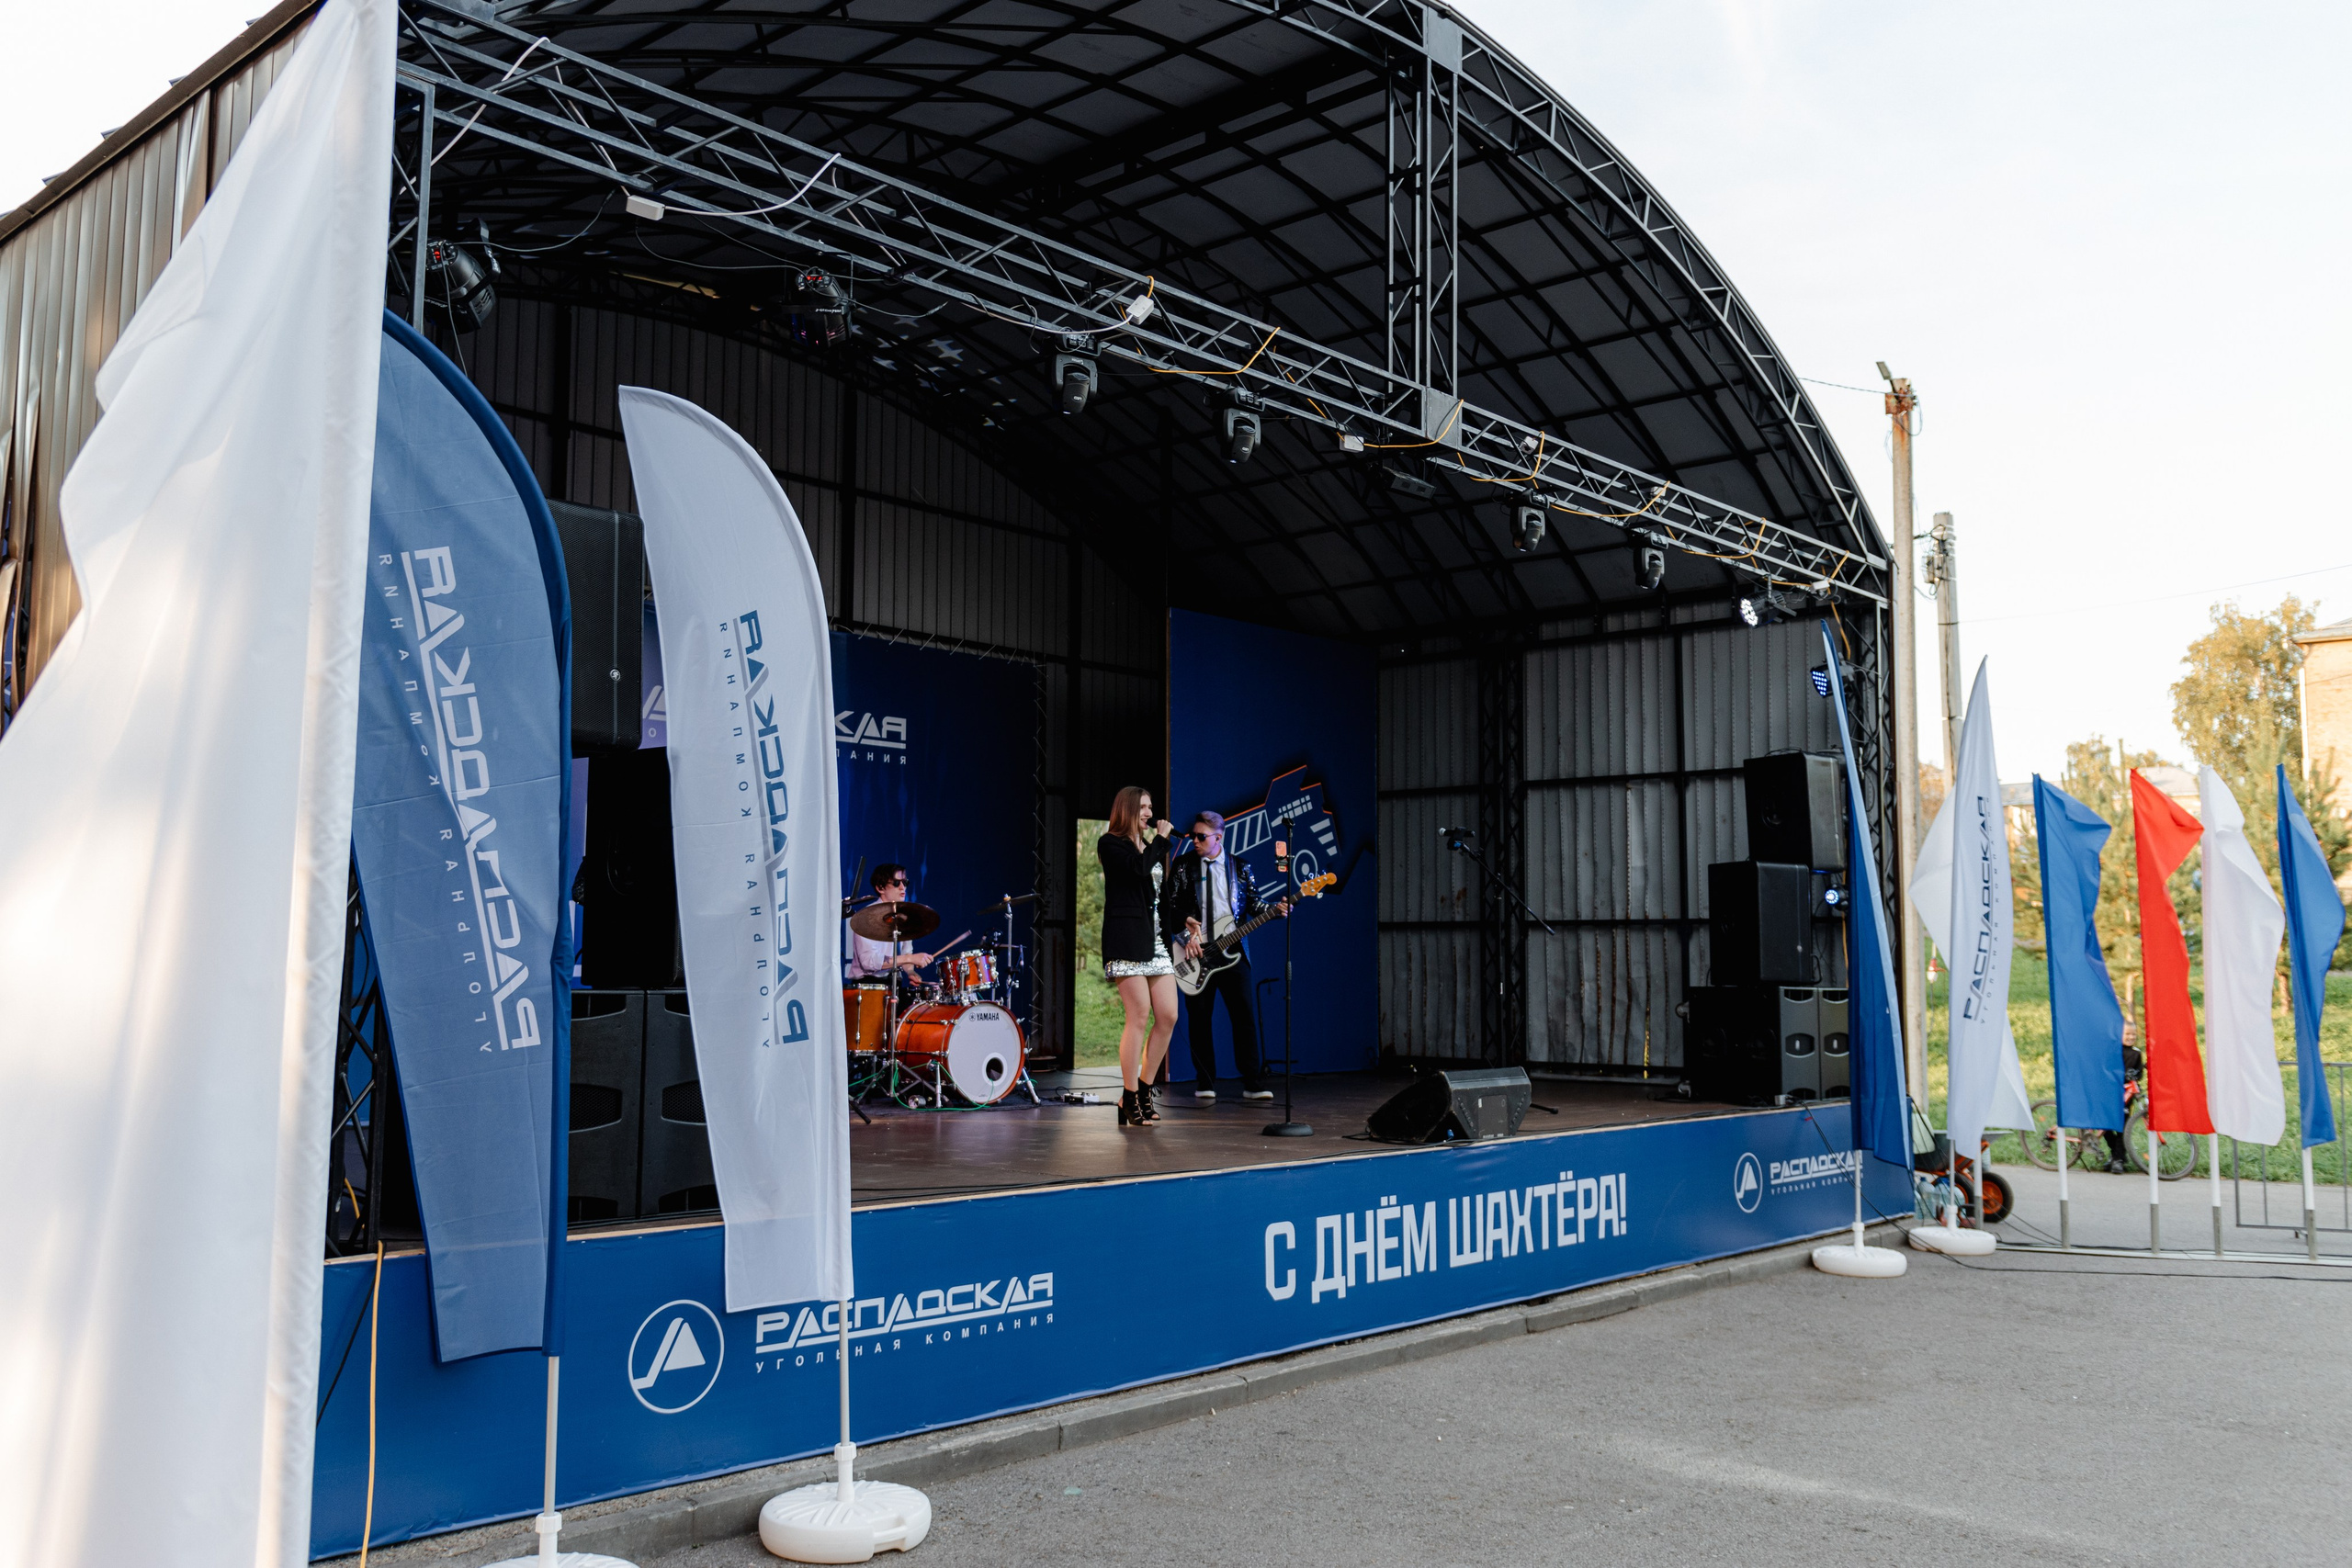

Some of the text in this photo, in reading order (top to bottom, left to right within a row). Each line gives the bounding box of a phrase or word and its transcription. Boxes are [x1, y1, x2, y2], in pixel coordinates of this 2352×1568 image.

[977, 1013, 1000, 1021] YAMAHA
[1265, 1170, 1627, 1304] С ДНЁМ ШАХТЁРА!
[755, 1272, 1054, 1354] РАСПАДСКАЯ
[925, 1313, 1054, 1345] КОМПАНИЯ
